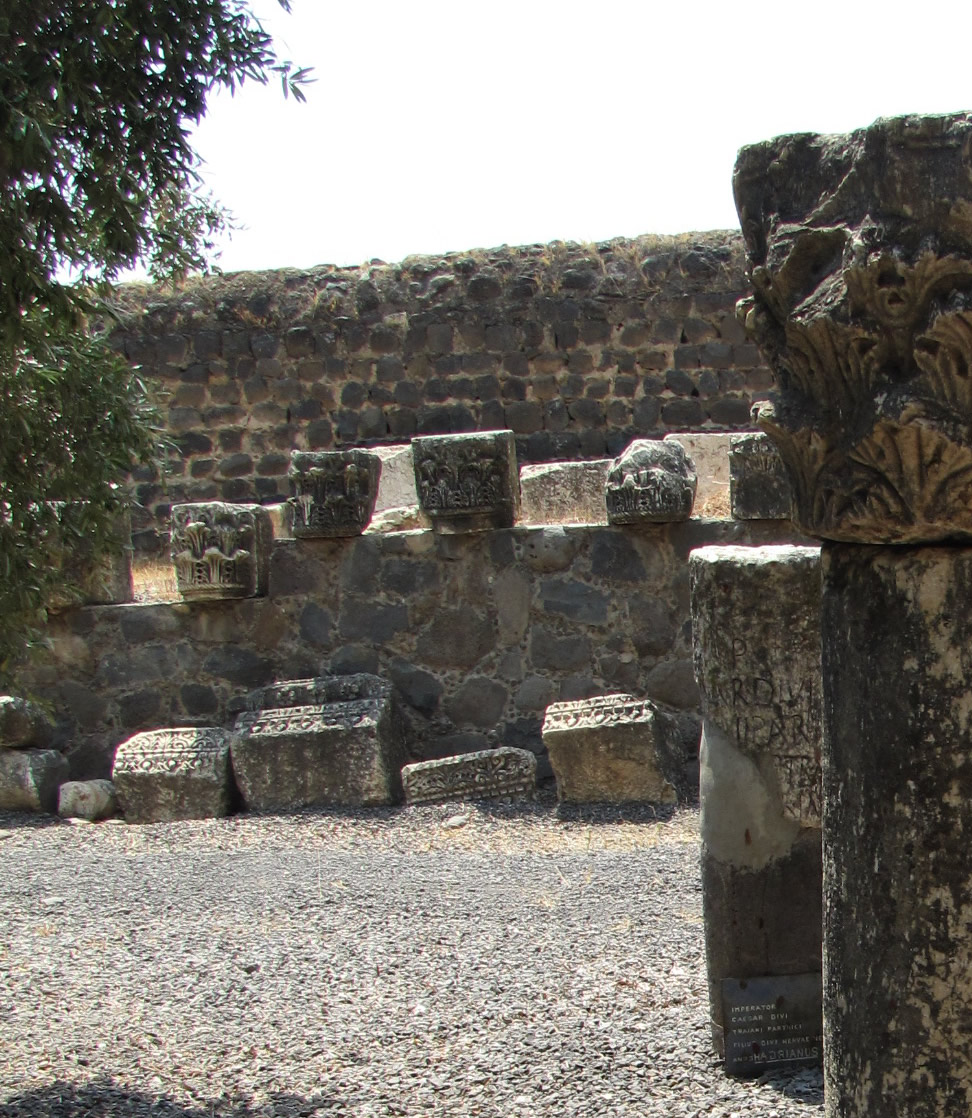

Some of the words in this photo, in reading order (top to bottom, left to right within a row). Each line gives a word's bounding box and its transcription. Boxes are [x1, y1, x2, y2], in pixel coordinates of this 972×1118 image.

[731, 1004, 777, 1013] IMPERATOR
[731, 1014, 763, 1023] CAESAR
[733, 1040, 756, 1048] FILIU
[754, 1047, 818, 1061] HADRIANUS
